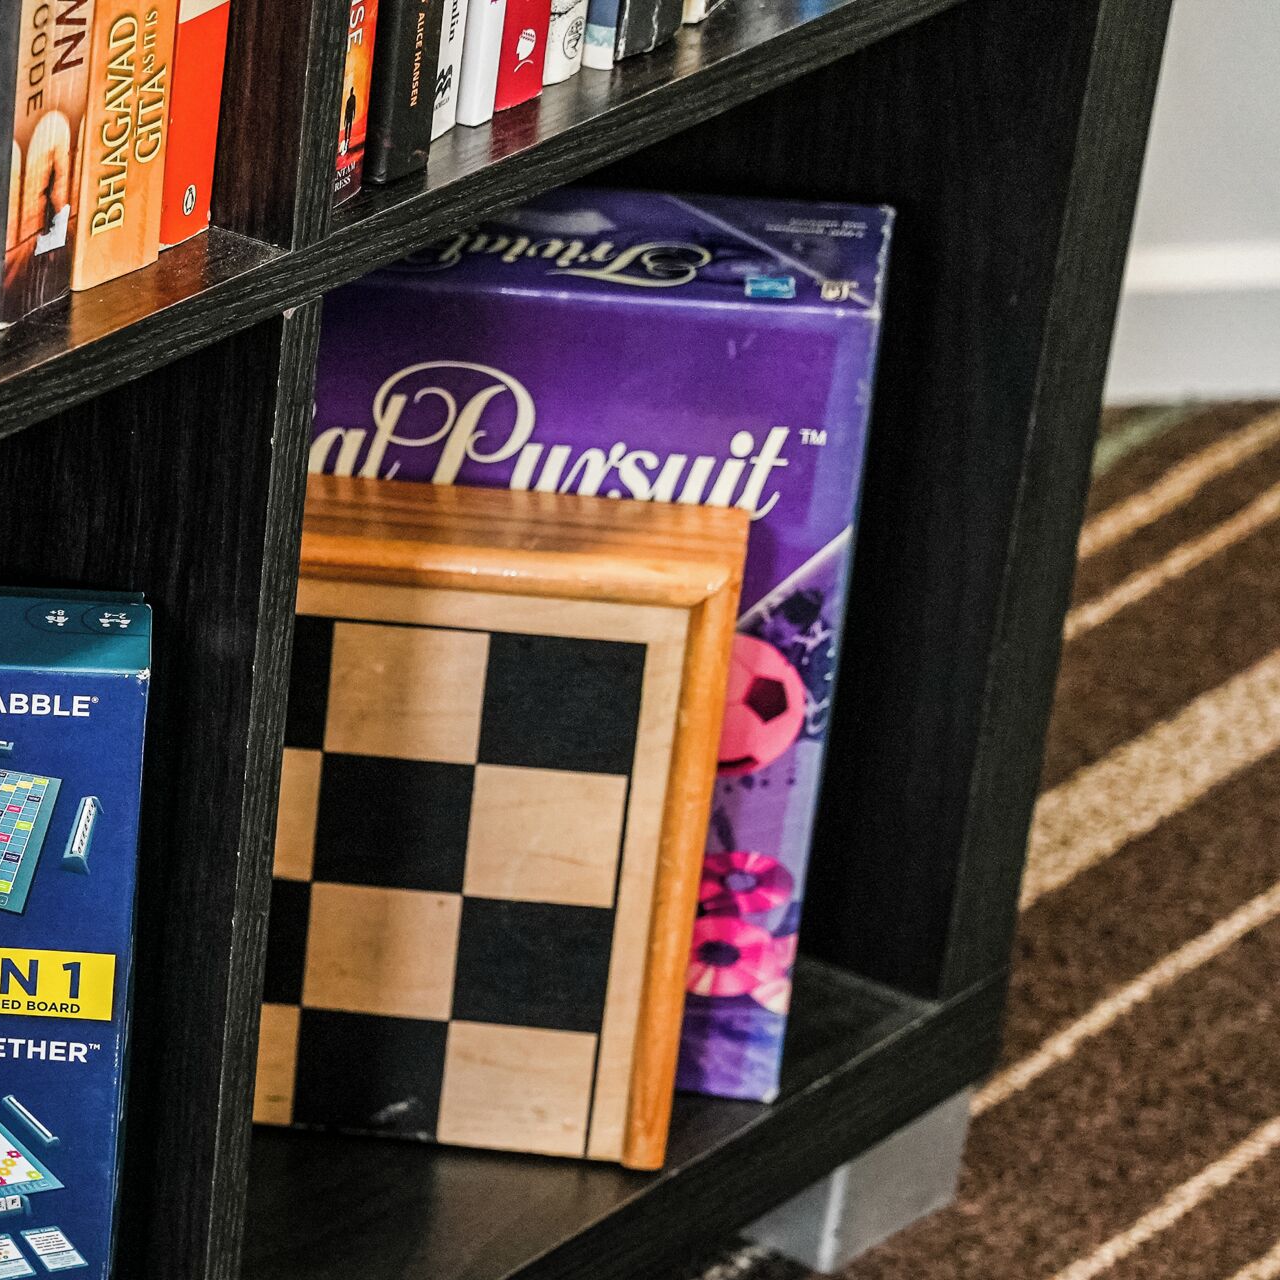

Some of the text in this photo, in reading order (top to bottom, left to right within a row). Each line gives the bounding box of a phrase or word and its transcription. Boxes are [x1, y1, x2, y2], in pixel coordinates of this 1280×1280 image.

[145, 9, 159, 28] IS
[347, 0, 365, 53] SE
[143, 32, 158, 50] IT
[26, 4, 50, 118] CODE
[142, 54, 156, 74] AS
[409, 12, 425, 109] ALICE HANSEN
[91, 15, 138, 238] BHAGAVAD
[333, 176, 352, 193] RESS
[62, 961, 83, 1000] 1
[26, 1000, 81, 1015] BOARD
